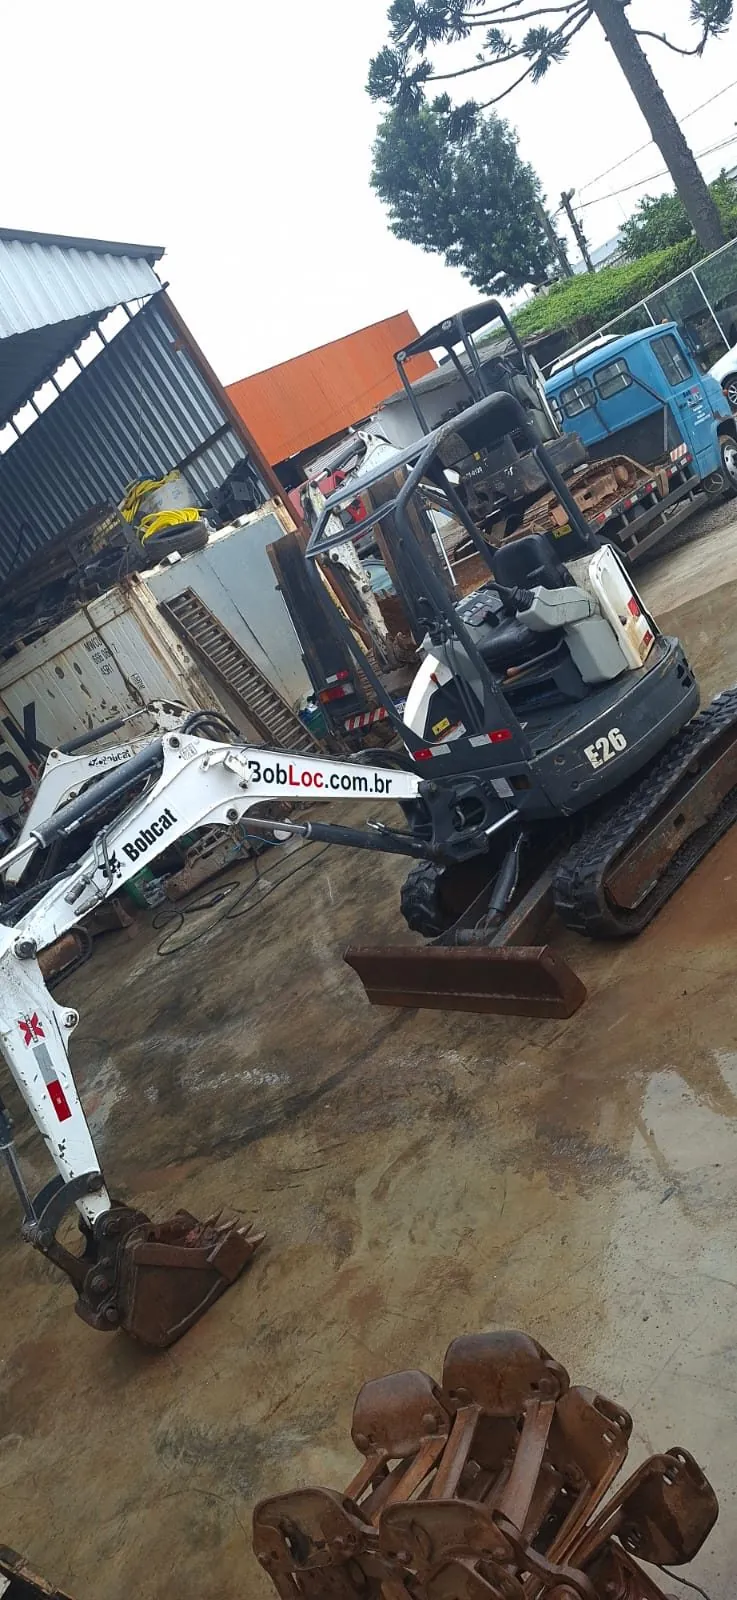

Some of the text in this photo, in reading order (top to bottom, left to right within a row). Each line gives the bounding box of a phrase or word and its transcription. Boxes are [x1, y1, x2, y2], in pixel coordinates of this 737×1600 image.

[583, 727, 627, 769] E26
[247, 760, 393, 794] BobLoc.com.br
[121, 807, 178, 862] Bobcat
